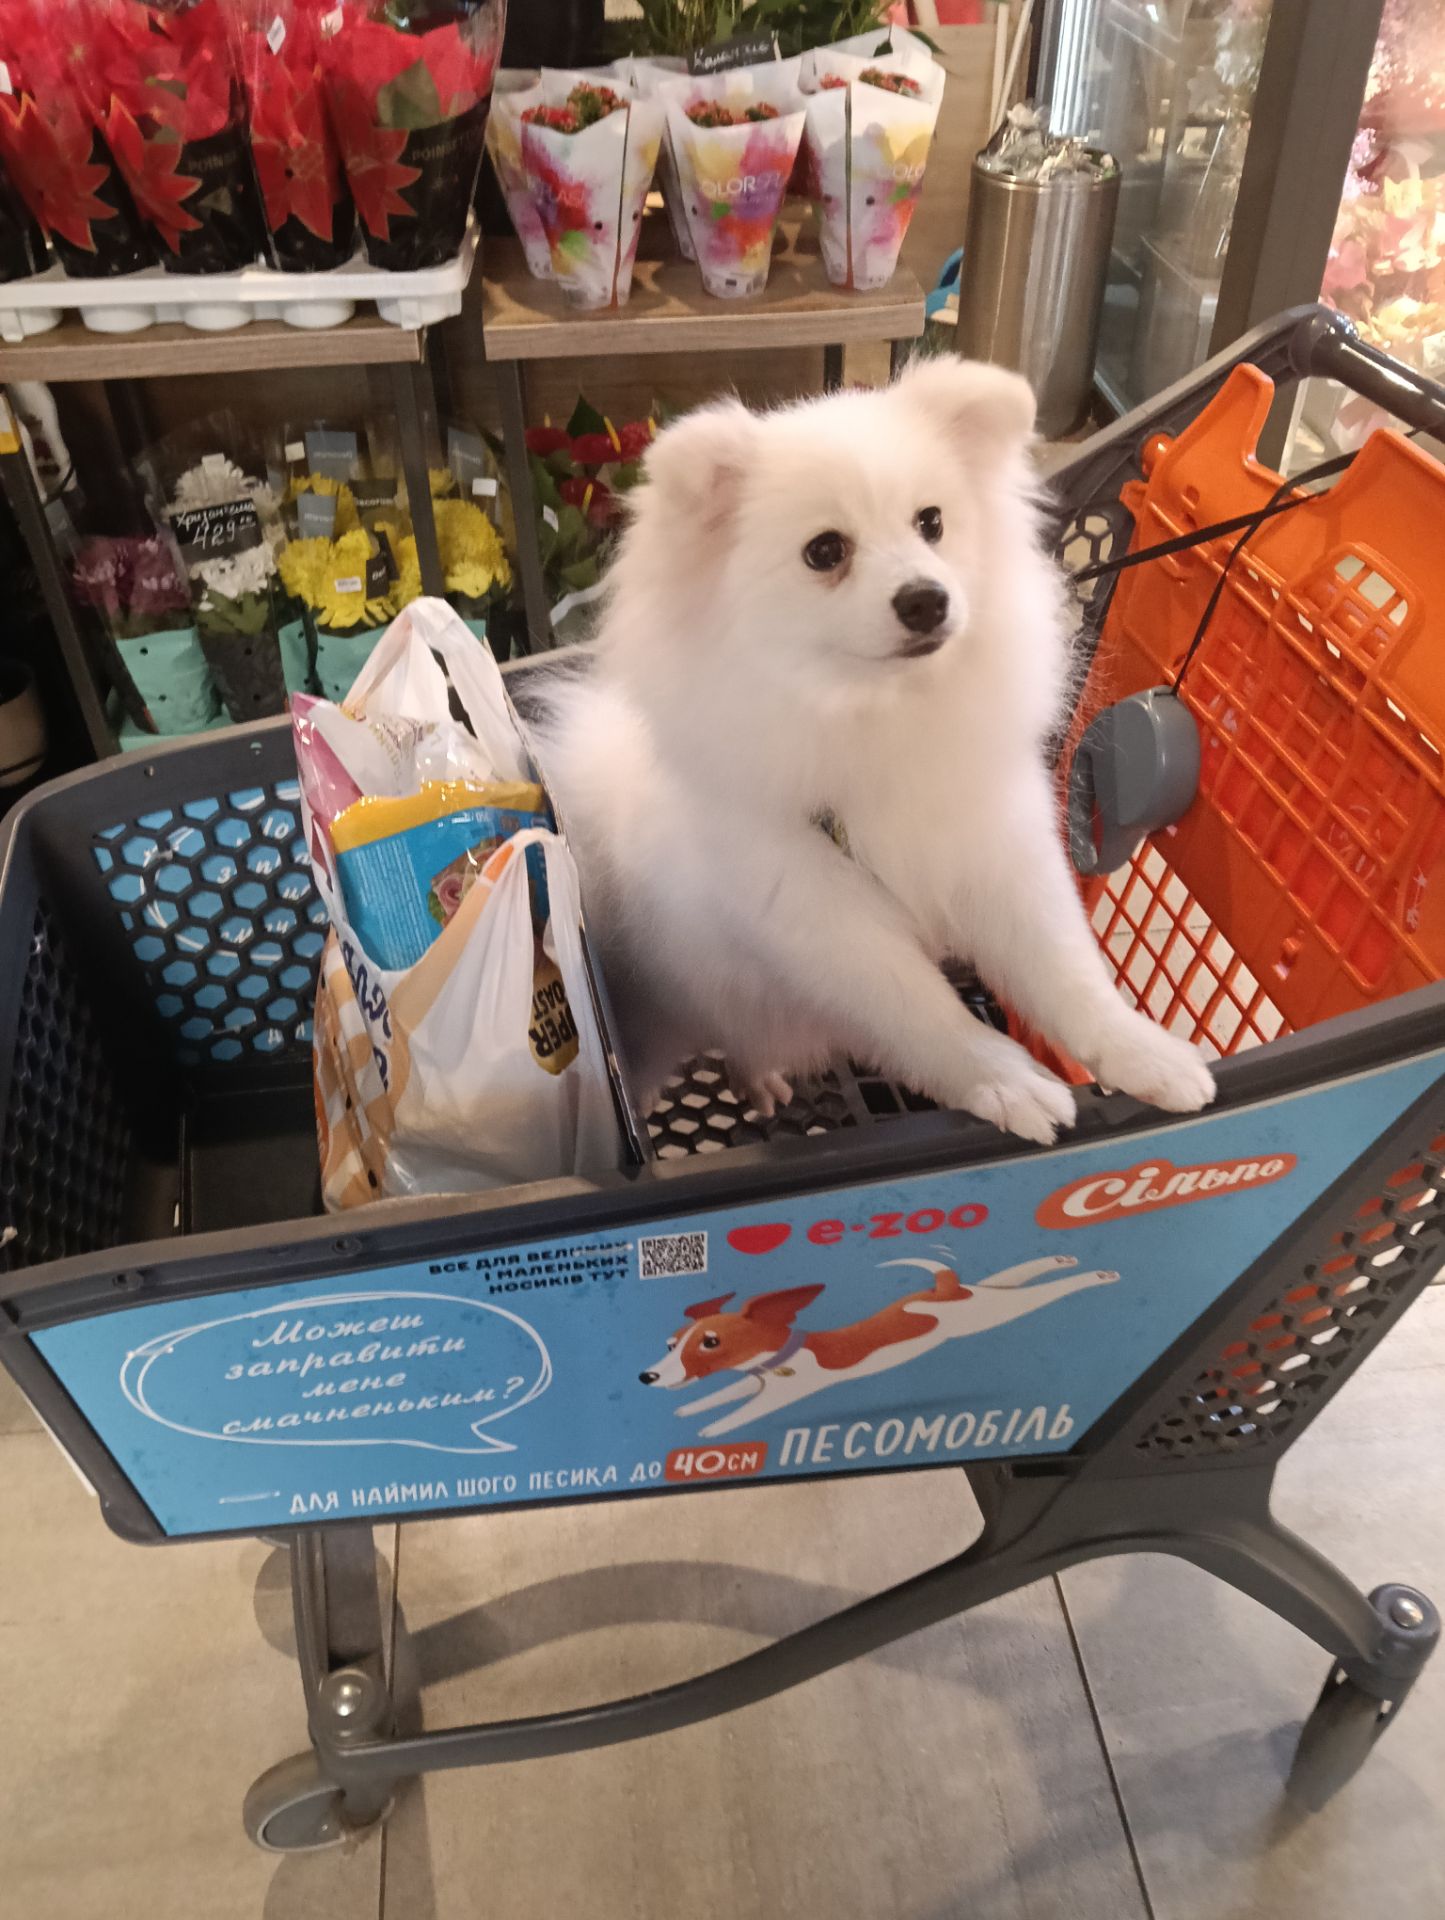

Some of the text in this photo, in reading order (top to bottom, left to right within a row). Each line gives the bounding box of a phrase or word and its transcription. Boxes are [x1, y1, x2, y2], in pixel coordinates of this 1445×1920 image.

[532, 981, 566, 1020] OAST
[1062, 1156, 1285, 1218] Сільпо
[806, 1203, 989, 1245] e-zoo
[429, 1260, 470, 1275] ВСЕ
[475, 1255, 521, 1271] ДЛЯ
[488, 1268, 630, 1295] НОСИКІВ ТУТ
[497, 1254, 629, 1281] МАЛЕНЬКИХ
[252, 1313, 425, 1348] Можеш
[224, 1336, 466, 1380] заправити
[222, 1376, 525, 1435] смачненьким?
[302, 1372, 407, 1399] мене
[778, 1403, 1076, 1467] ПЕСОМОБІЛЬ
[289, 1490, 340, 1516] ДЛЯ
[529, 1465, 618, 1491] ПЕСИКА
[629, 1460, 662, 1484] ДО
